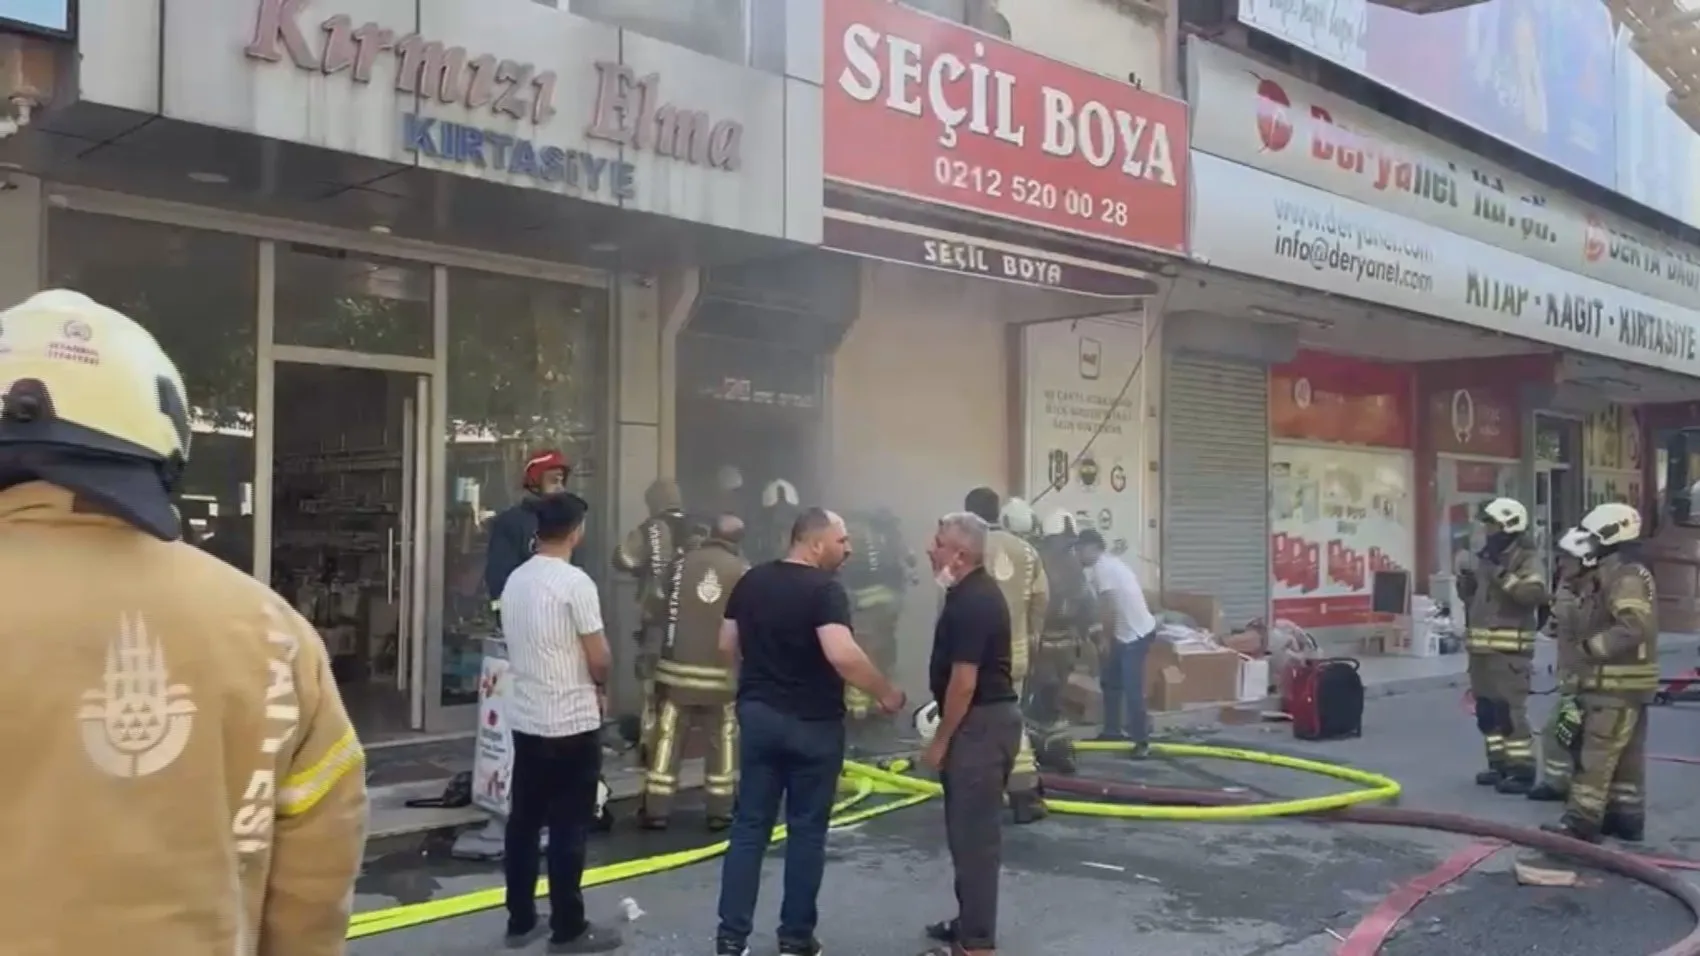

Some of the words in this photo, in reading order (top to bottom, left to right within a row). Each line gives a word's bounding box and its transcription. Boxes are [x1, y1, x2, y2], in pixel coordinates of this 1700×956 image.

[584, 61, 744, 172] Elma
[838, 22, 1025, 148] SEÇİL
[1041, 86, 1177, 187] BOYA
[935, 156, 1002, 197] 0212
[1011, 175, 1056, 209] 520
[1064, 189, 1093, 218] 00
[1100, 198, 1128, 226] 28
[924, 240, 989, 271] SEÇİL
[1003, 255, 1062, 284] BOYA
[1275, 225, 1434, 293] info@deryanet.com
